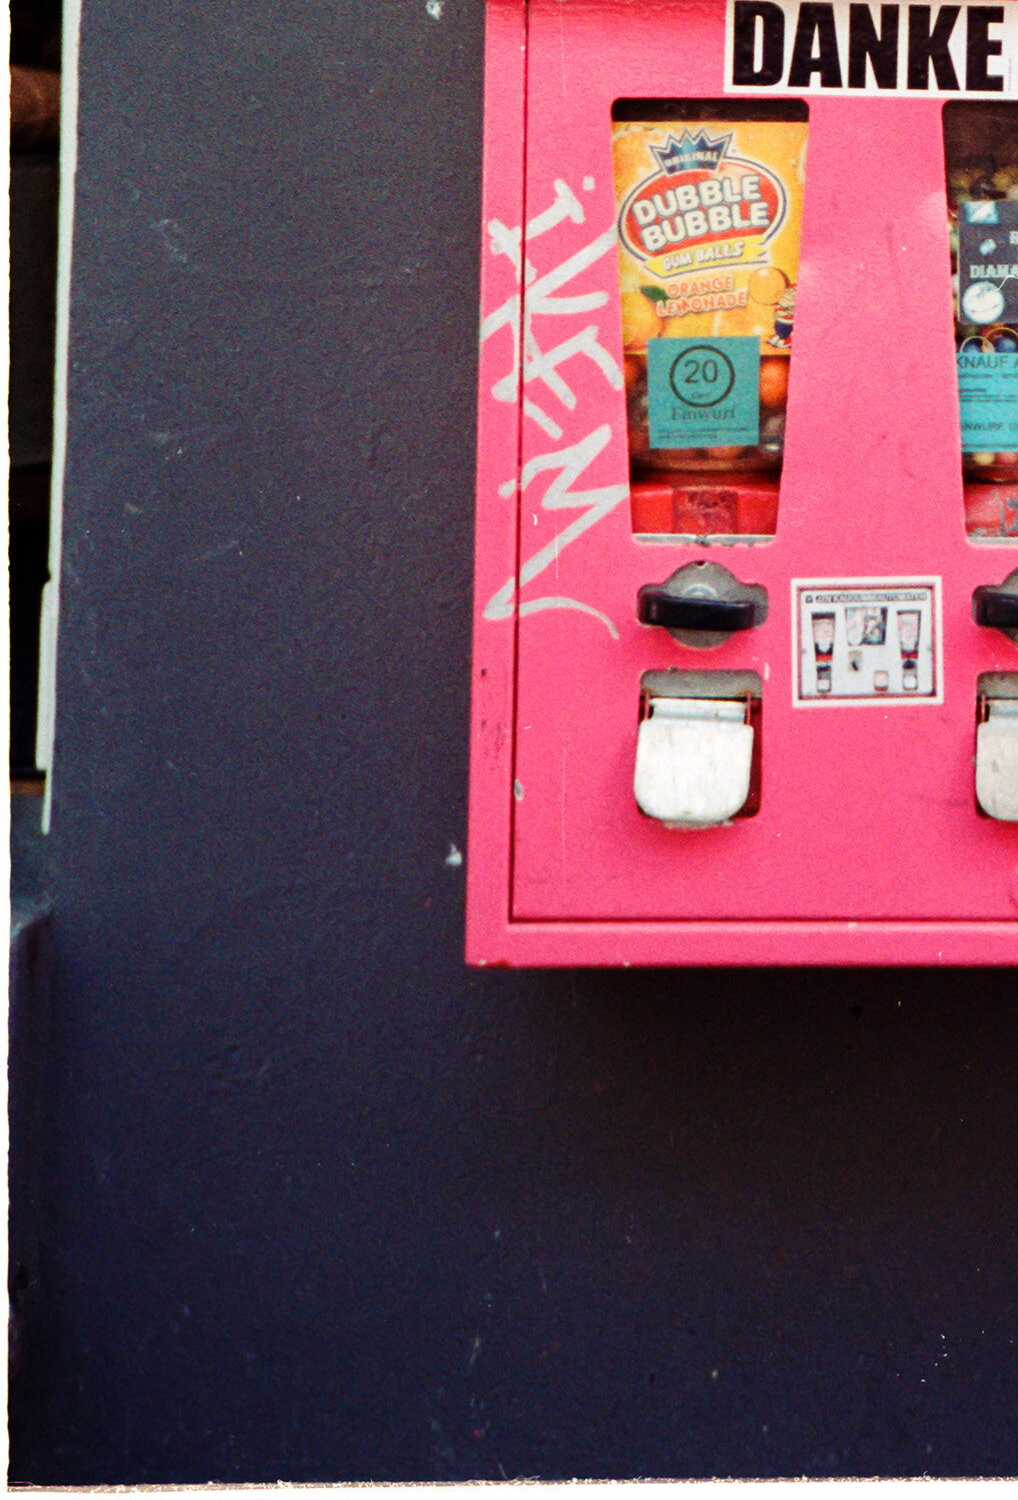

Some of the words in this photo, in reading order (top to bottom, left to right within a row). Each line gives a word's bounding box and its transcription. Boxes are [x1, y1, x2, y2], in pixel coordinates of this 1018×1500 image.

[732, 0, 1004, 92] DANKE
[664, 150, 719, 168] ORIGINAL
[632, 173, 762, 227] DUBBLE
[640, 201, 770, 253] BUBBLE
[662, 252, 693, 272] GUM
[694, 240, 745, 264] BALLS
[667, 276, 735, 298] ORANGE
[656, 290, 748, 318] LEMONADE
[684, 359, 719, 384] 20
